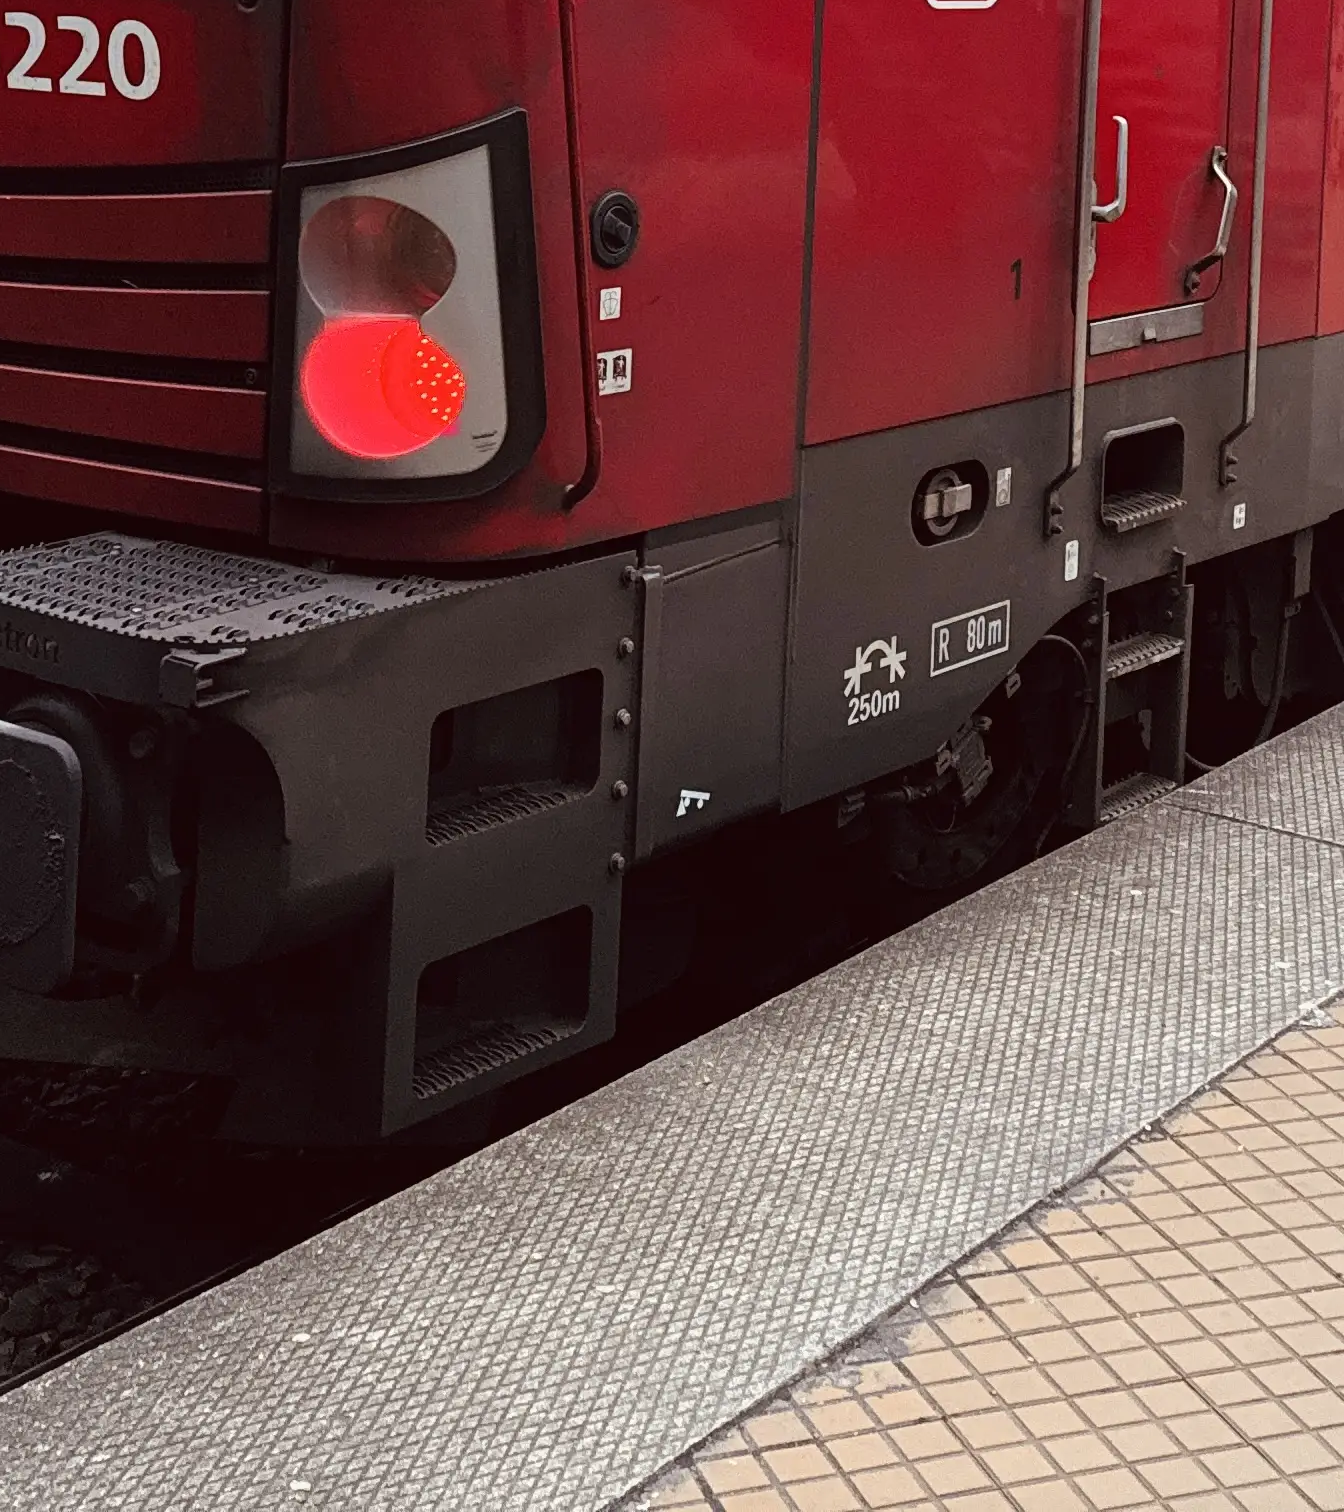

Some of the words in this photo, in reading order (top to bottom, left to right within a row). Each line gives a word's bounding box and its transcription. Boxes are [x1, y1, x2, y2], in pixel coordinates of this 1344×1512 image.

[1010, 258, 1022, 300] 1
[938, 627, 950, 663] R
[847, 689, 901, 726] 250m
